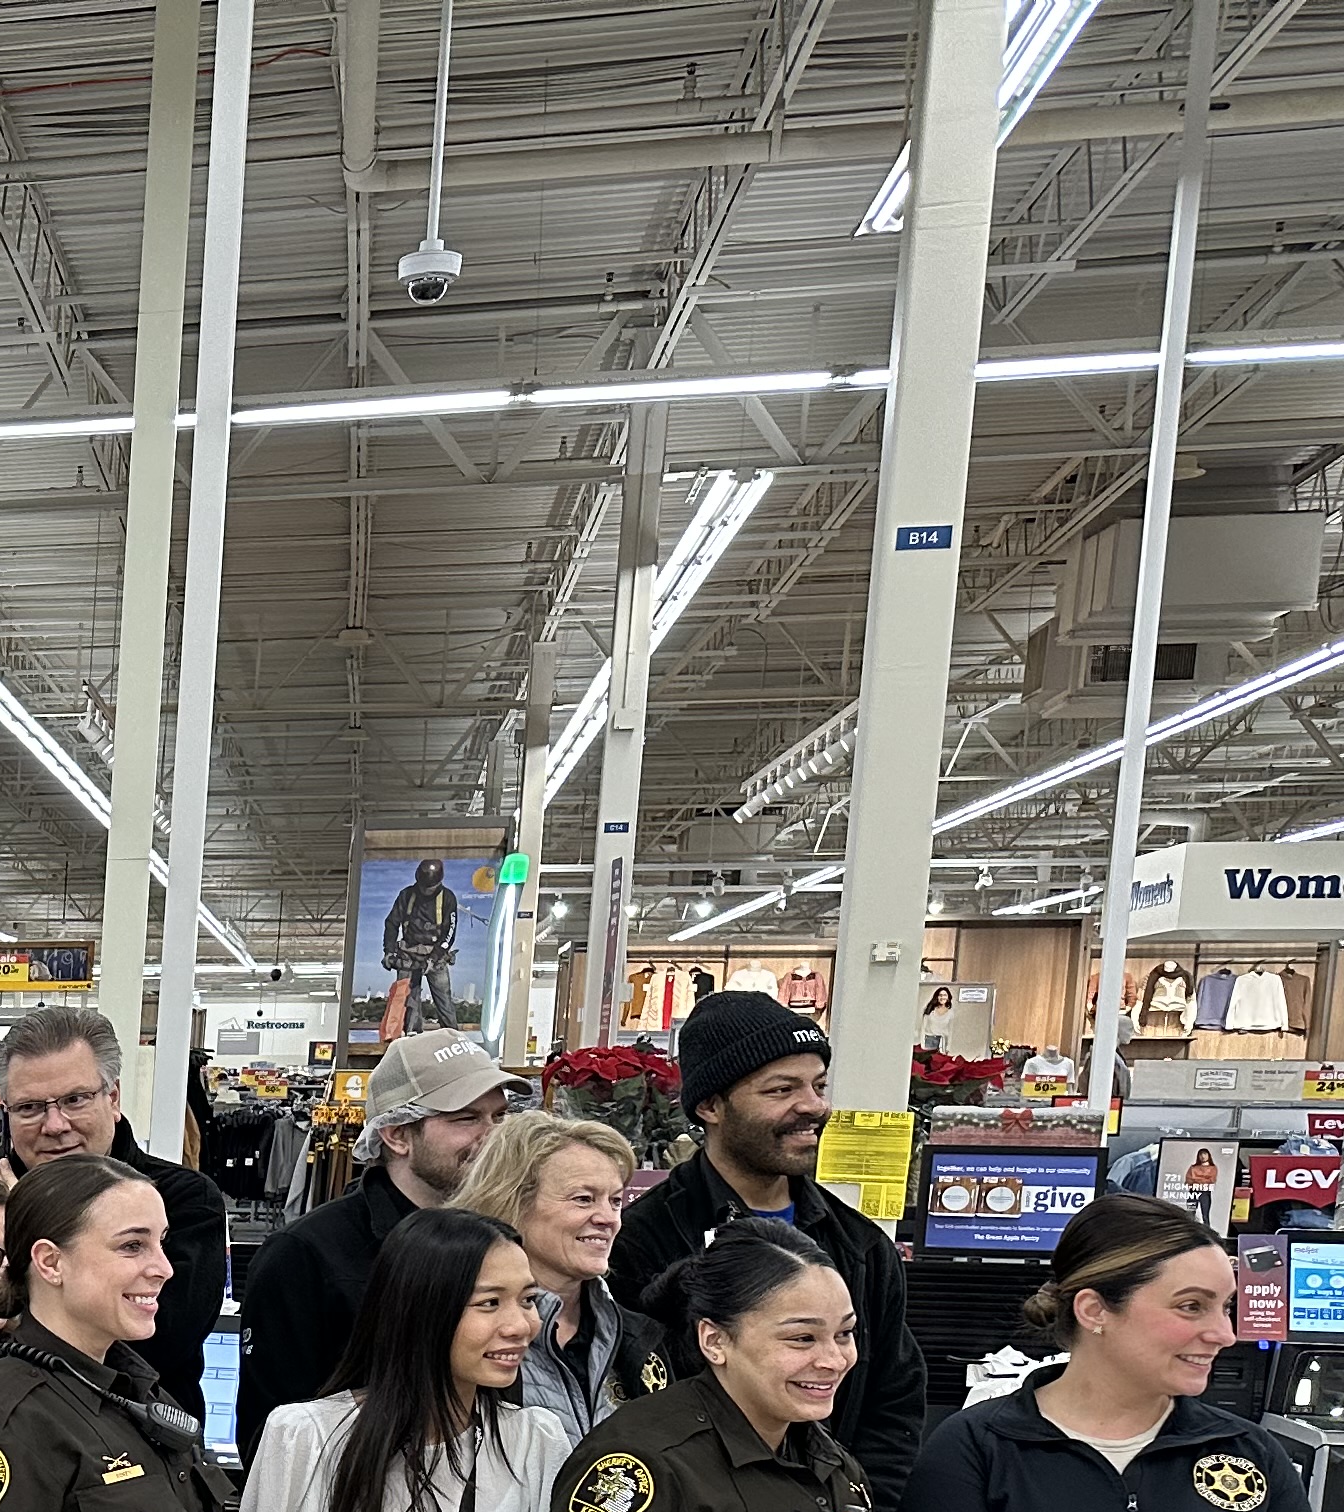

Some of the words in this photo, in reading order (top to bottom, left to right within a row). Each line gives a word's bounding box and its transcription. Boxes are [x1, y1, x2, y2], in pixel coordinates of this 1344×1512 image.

[909, 531, 938, 544] B14
[246, 1020, 305, 1030] Restrooms
[1163, 1183, 1215, 1192] HIGH-RISE
[1032, 1185, 1086, 1214] give
[1162, 1191, 1202, 1200] SKINNY
[1244, 1282, 1282, 1298] apply
[1248, 1299, 1277, 1309] now
